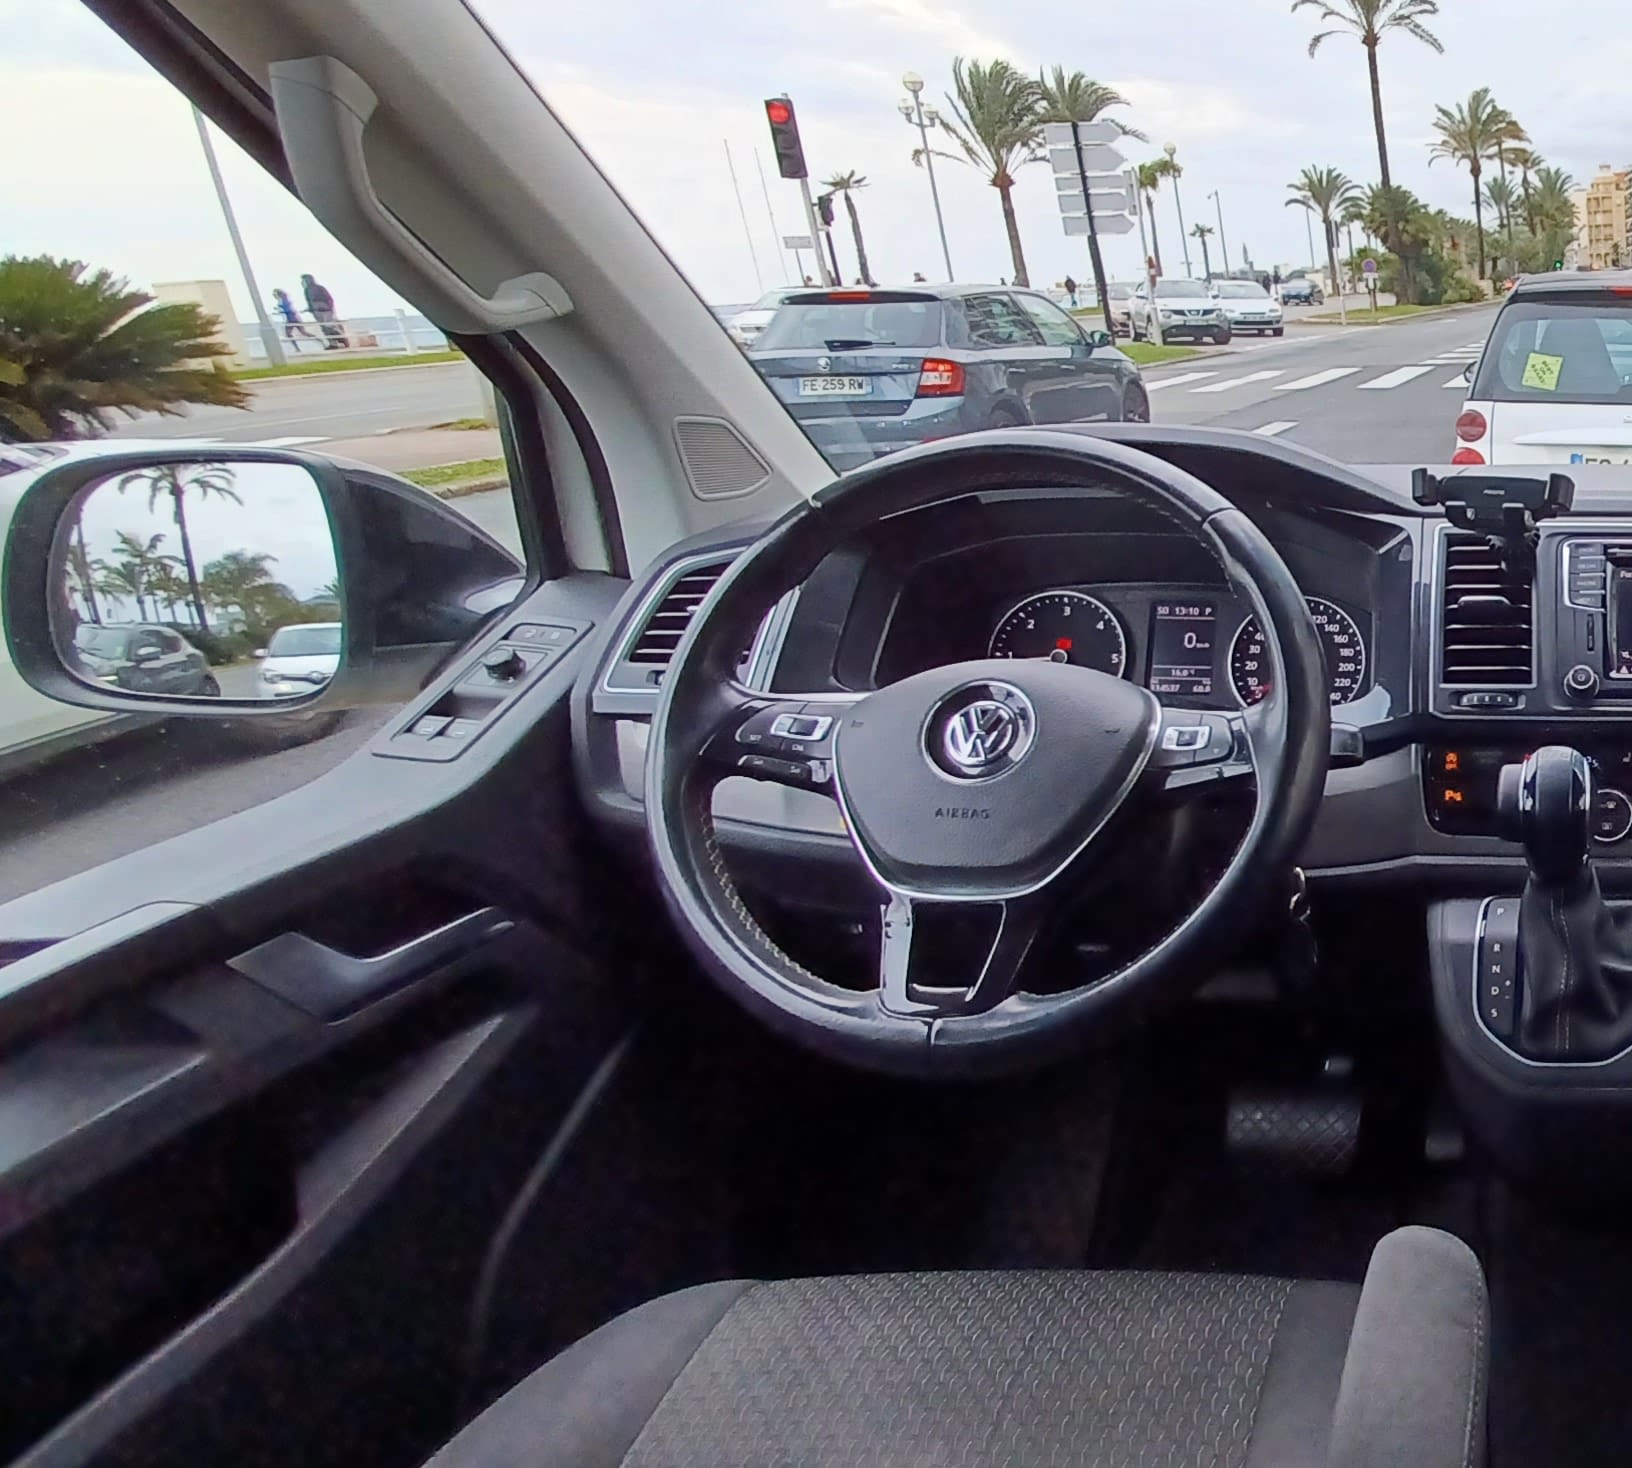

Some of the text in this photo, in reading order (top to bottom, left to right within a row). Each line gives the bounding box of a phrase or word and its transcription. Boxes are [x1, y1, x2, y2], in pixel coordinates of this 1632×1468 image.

[1063, 606, 1071, 616] 3
[1027, 619, 1035, 629] 2
[1096, 620, 1104, 630] 4
[1184, 632, 1197, 649] 0
[1248, 645, 1261, 654] 30
[1111, 653, 1119, 664] 5
[1245, 661, 1258, 671] 20
[1247, 677, 1259, 686] 10
[935, 807, 990, 819] AIRBAG
[1493, 943, 1501, 953] R
[1491, 965, 1501, 974] N
[1491, 986, 1500, 996] D
[1490, 1008, 1498, 1018] S
